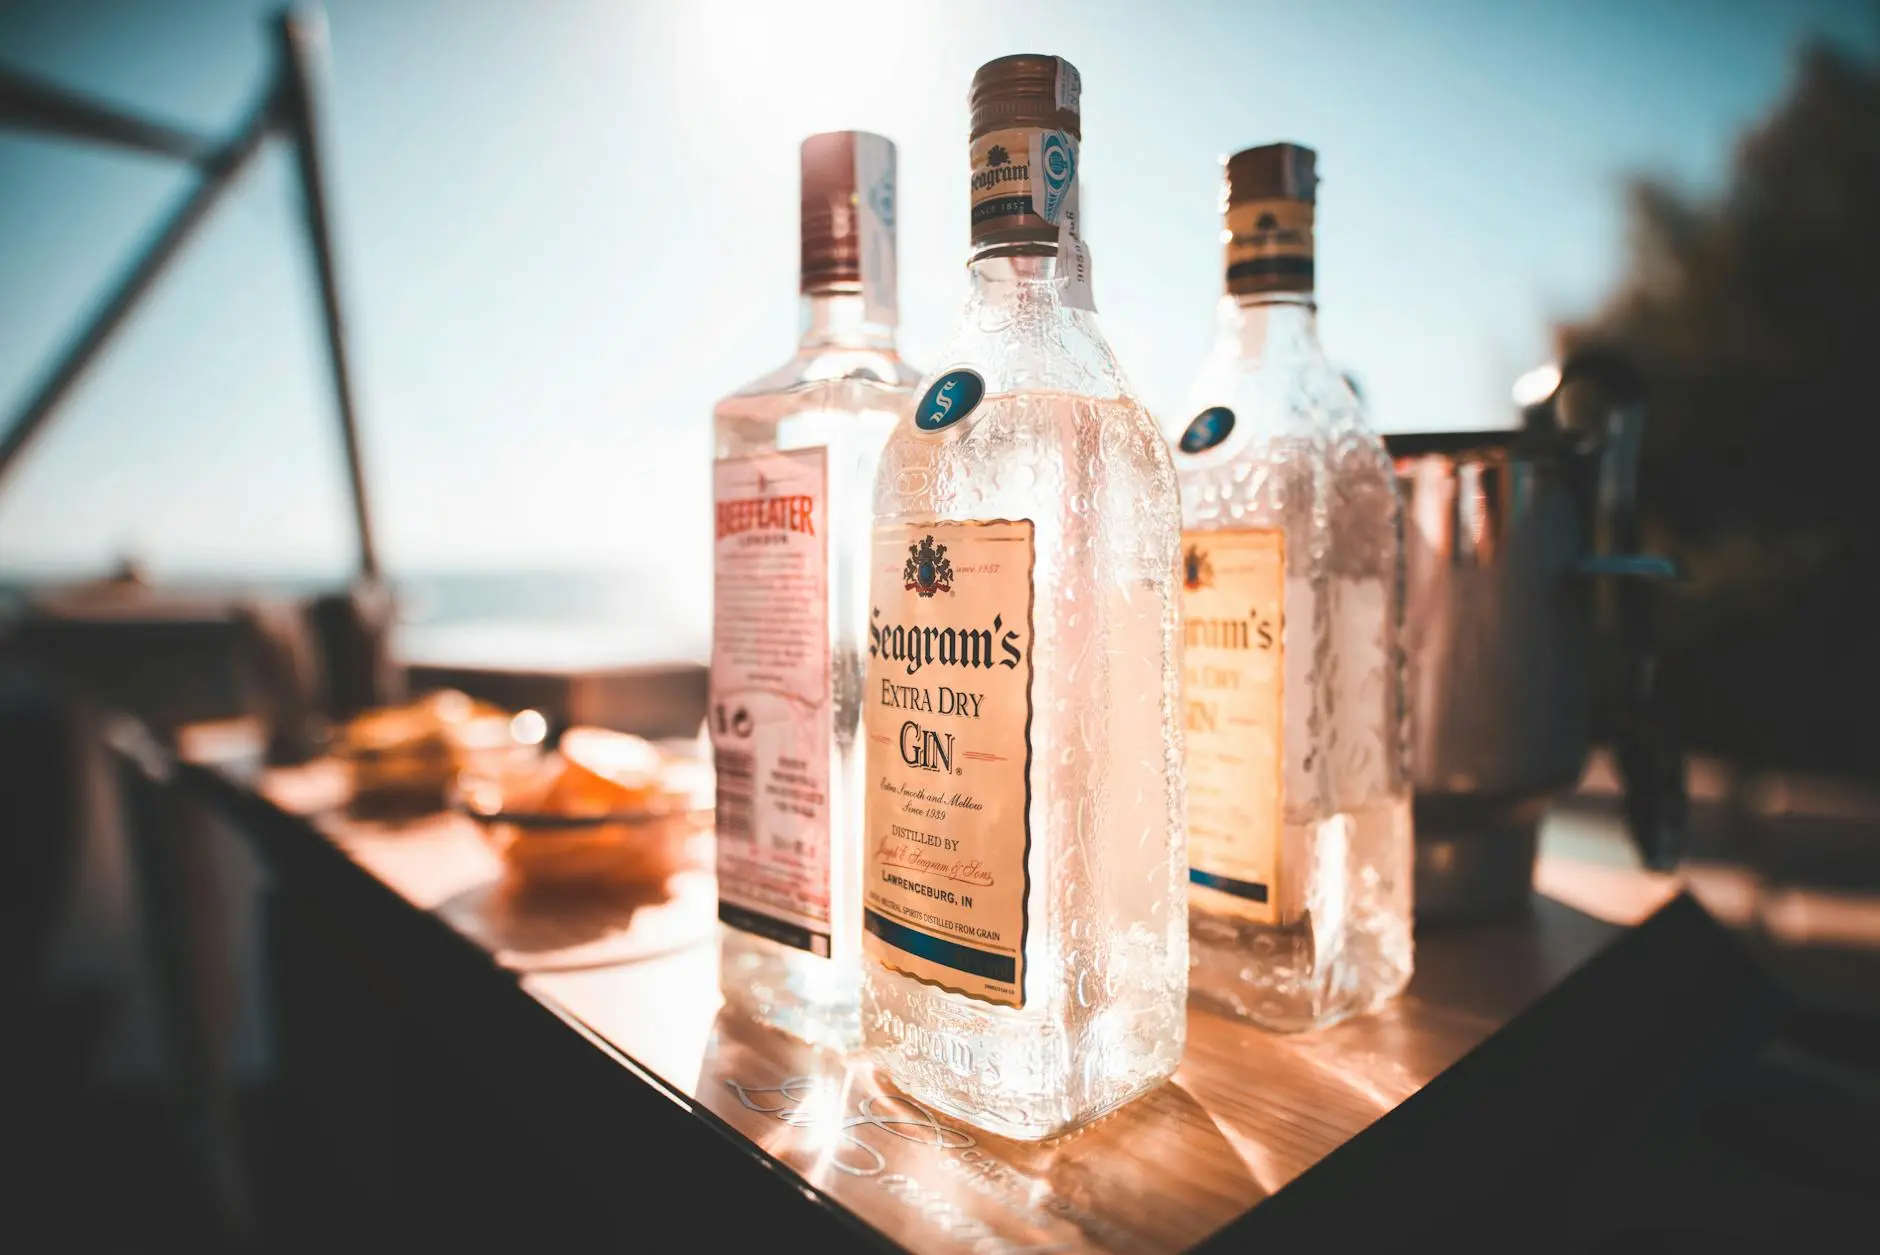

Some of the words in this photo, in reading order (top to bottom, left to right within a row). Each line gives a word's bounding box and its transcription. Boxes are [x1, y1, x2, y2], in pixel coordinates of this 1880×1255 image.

[869, 606, 1022, 675] Seagram's
[881, 678, 933, 712] EXTRA
[938, 686, 985, 718] DRY
[899, 720, 957, 774] GIN
[926, 792, 945, 806] and
[943, 793, 984, 811] Mellow
[891, 824, 942, 848] DISTILLED
[944, 838, 960, 852] BY
[961, 896, 973, 908] IN
[923, 910, 954, 930] DISTILLED
[954, 923, 976, 937] FROM
[976, 929, 1000, 942] GRAIN
